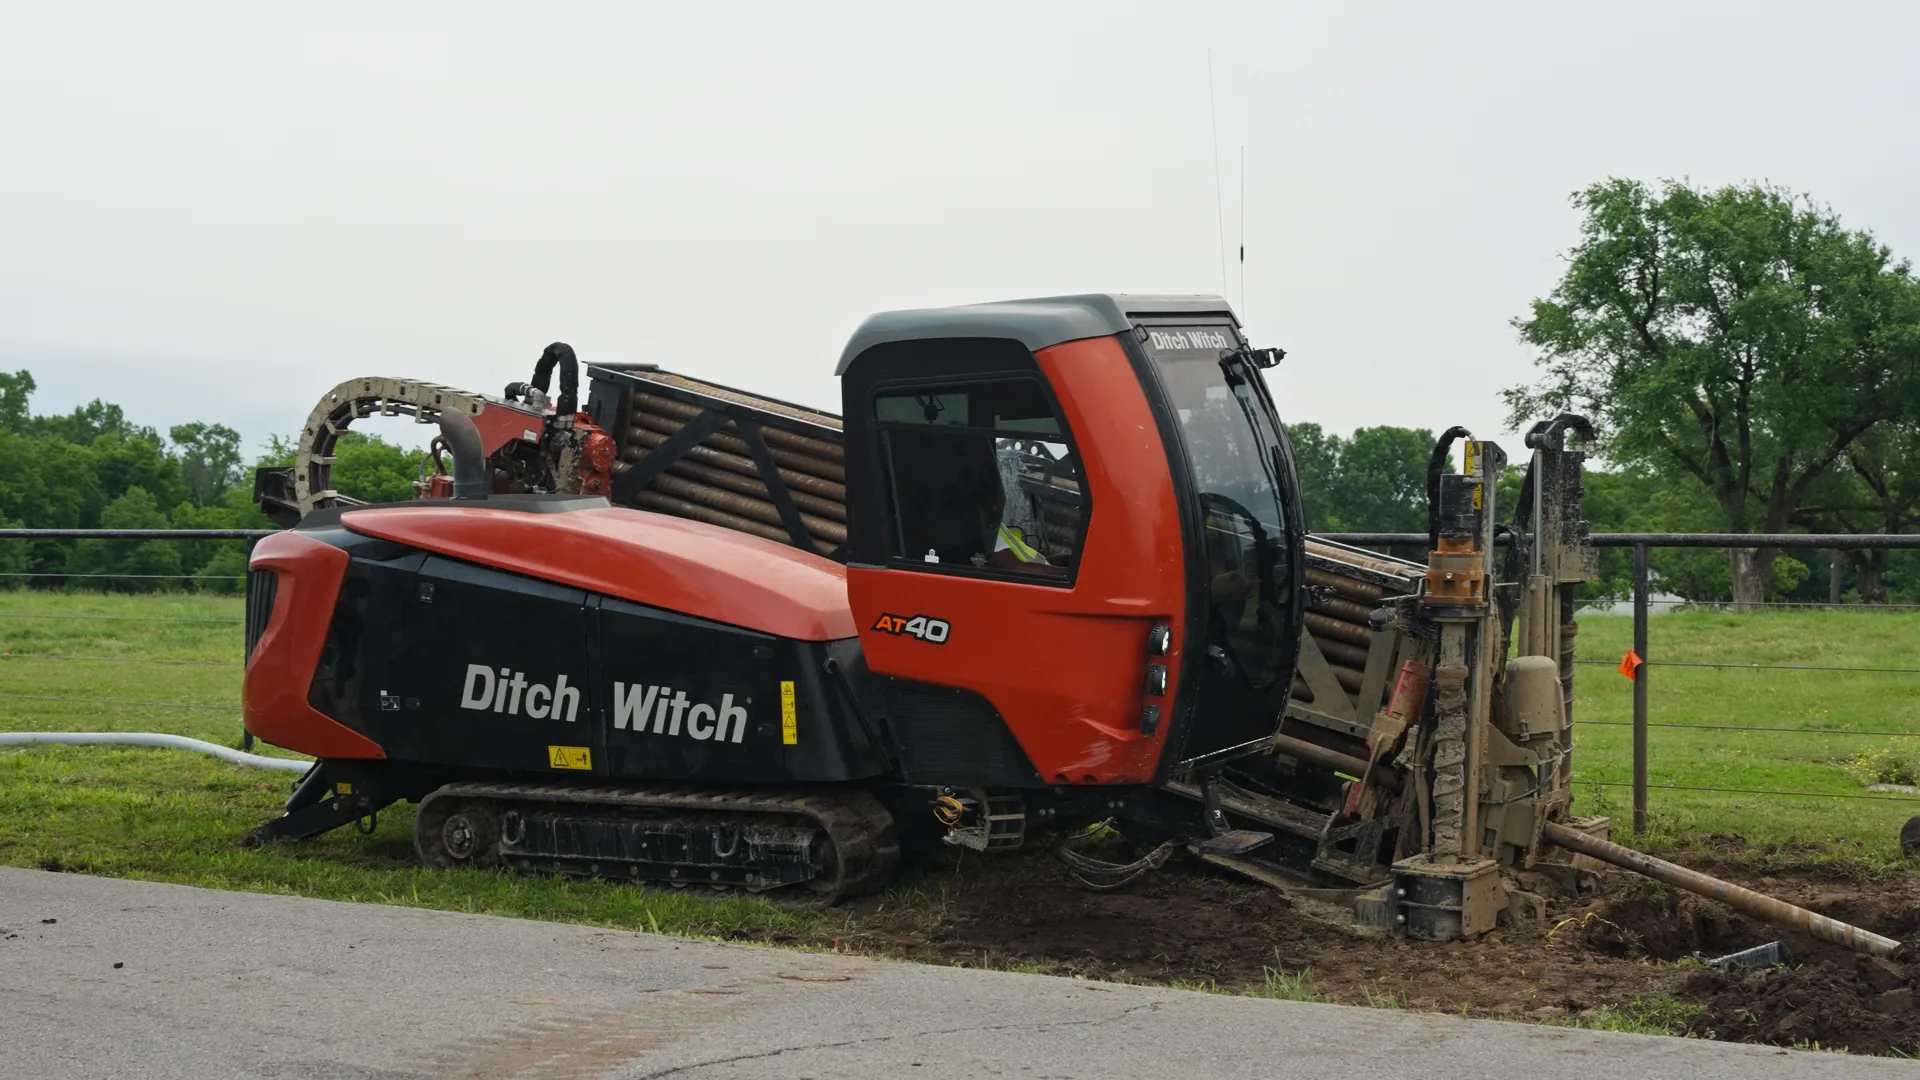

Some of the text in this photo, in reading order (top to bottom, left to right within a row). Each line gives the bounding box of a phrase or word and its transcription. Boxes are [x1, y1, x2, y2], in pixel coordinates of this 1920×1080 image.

[1150, 330, 1228, 350] Ditch Witch
[875, 615, 950, 643] AT40
[461, 663, 749, 744] Ditch Witch
